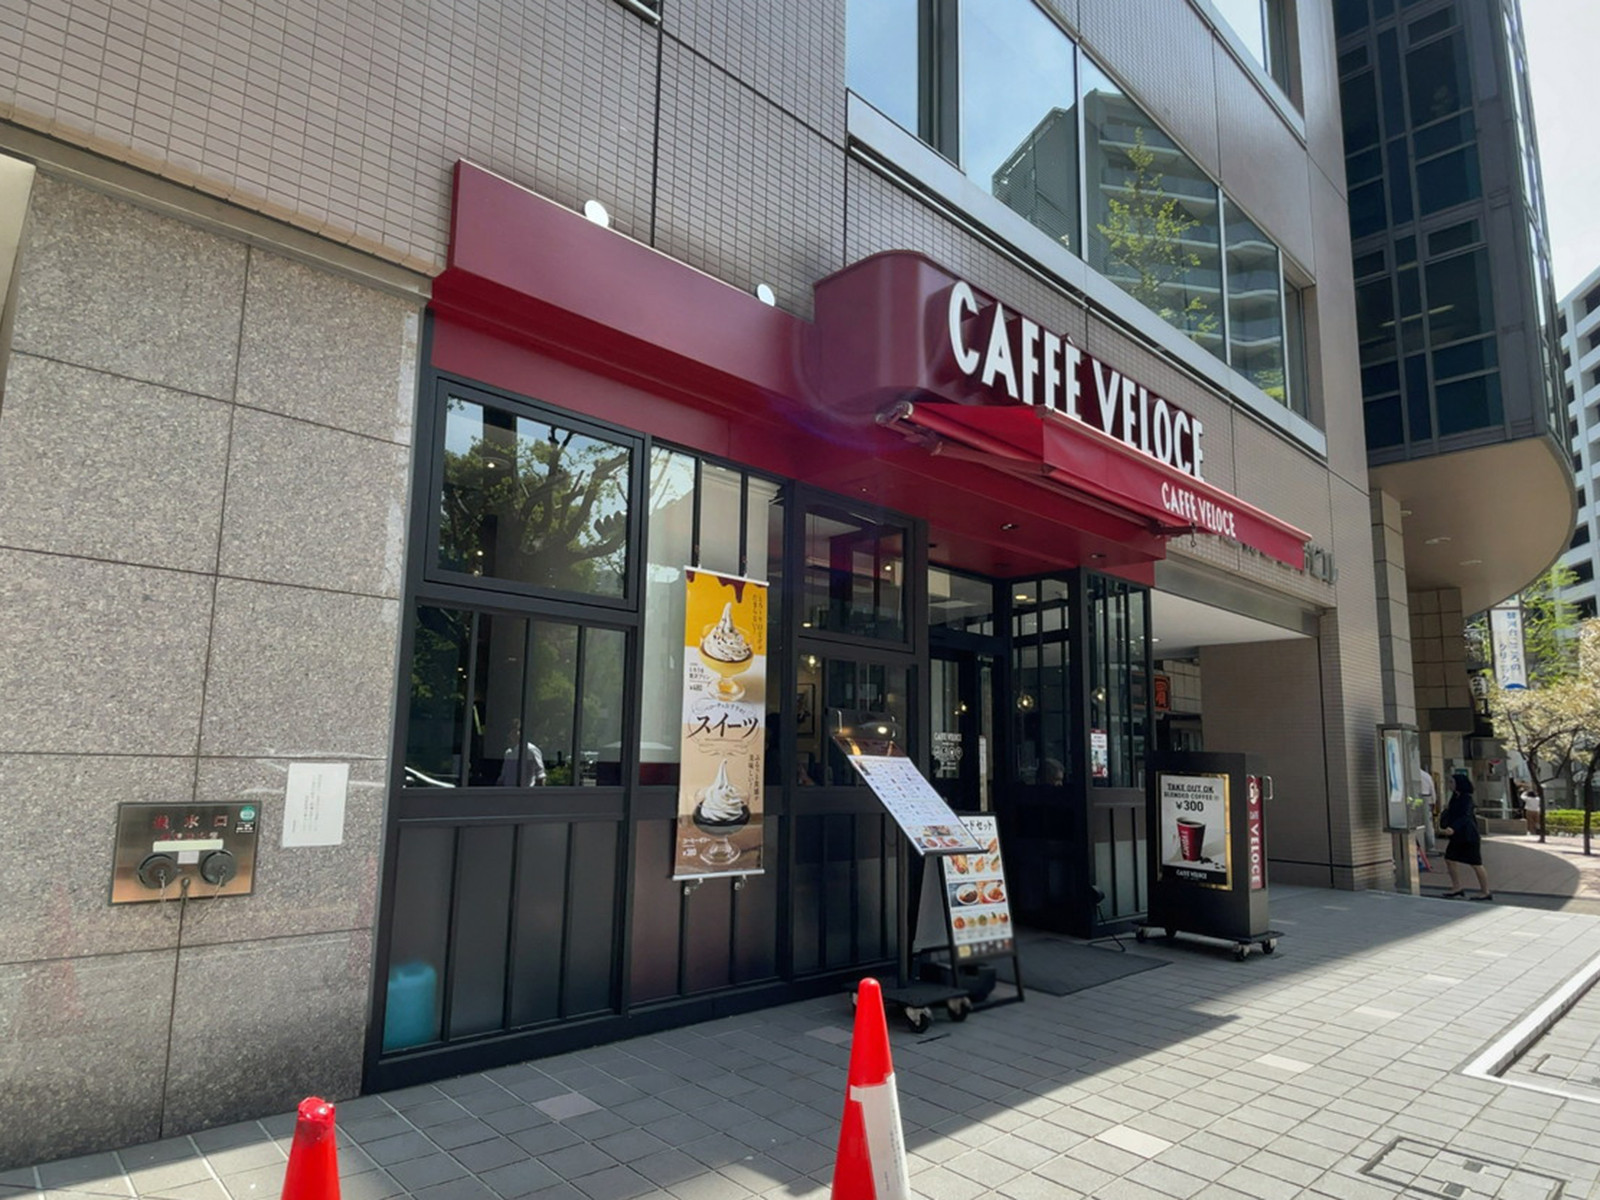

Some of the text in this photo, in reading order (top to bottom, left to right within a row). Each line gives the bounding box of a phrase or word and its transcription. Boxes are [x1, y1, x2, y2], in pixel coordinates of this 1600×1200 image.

[1092, 357, 1206, 482] VELOCE
[1198, 498, 1237, 538] VELOCE
[687, 712, 759, 740] スイーツ
[1164, 791, 1190, 799] BLENDED
[1167, 783, 1215, 793] TAKE OUT OK
[1176, 800, 1204, 812] ¥300
[1250, 823, 1261, 884] VELOCE
